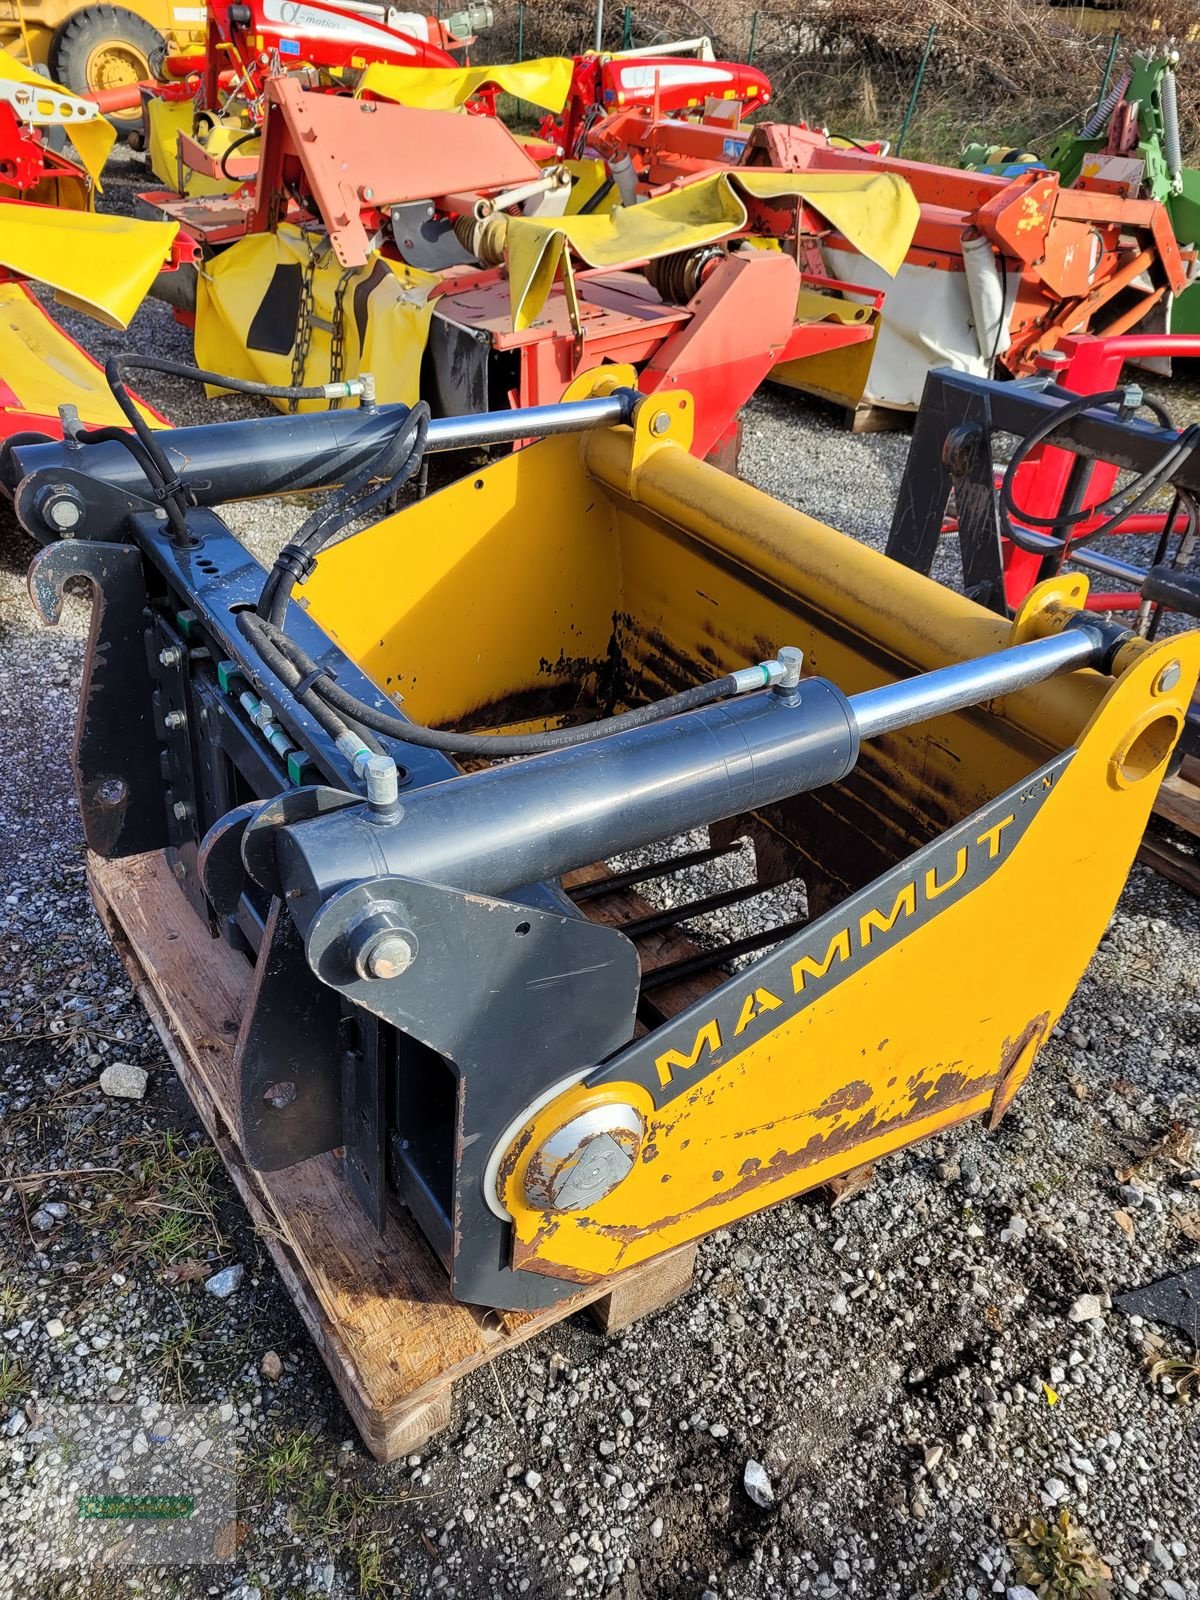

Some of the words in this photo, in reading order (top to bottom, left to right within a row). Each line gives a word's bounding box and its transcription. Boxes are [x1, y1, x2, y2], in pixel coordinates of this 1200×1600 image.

[529, 735, 573, 748] SYSTEMFLEX
[576, 732, 589, 742] DIN
[1019, 772, 1054, 808] SC-N
[654, 813, 1016, 1090] MAMMUT
